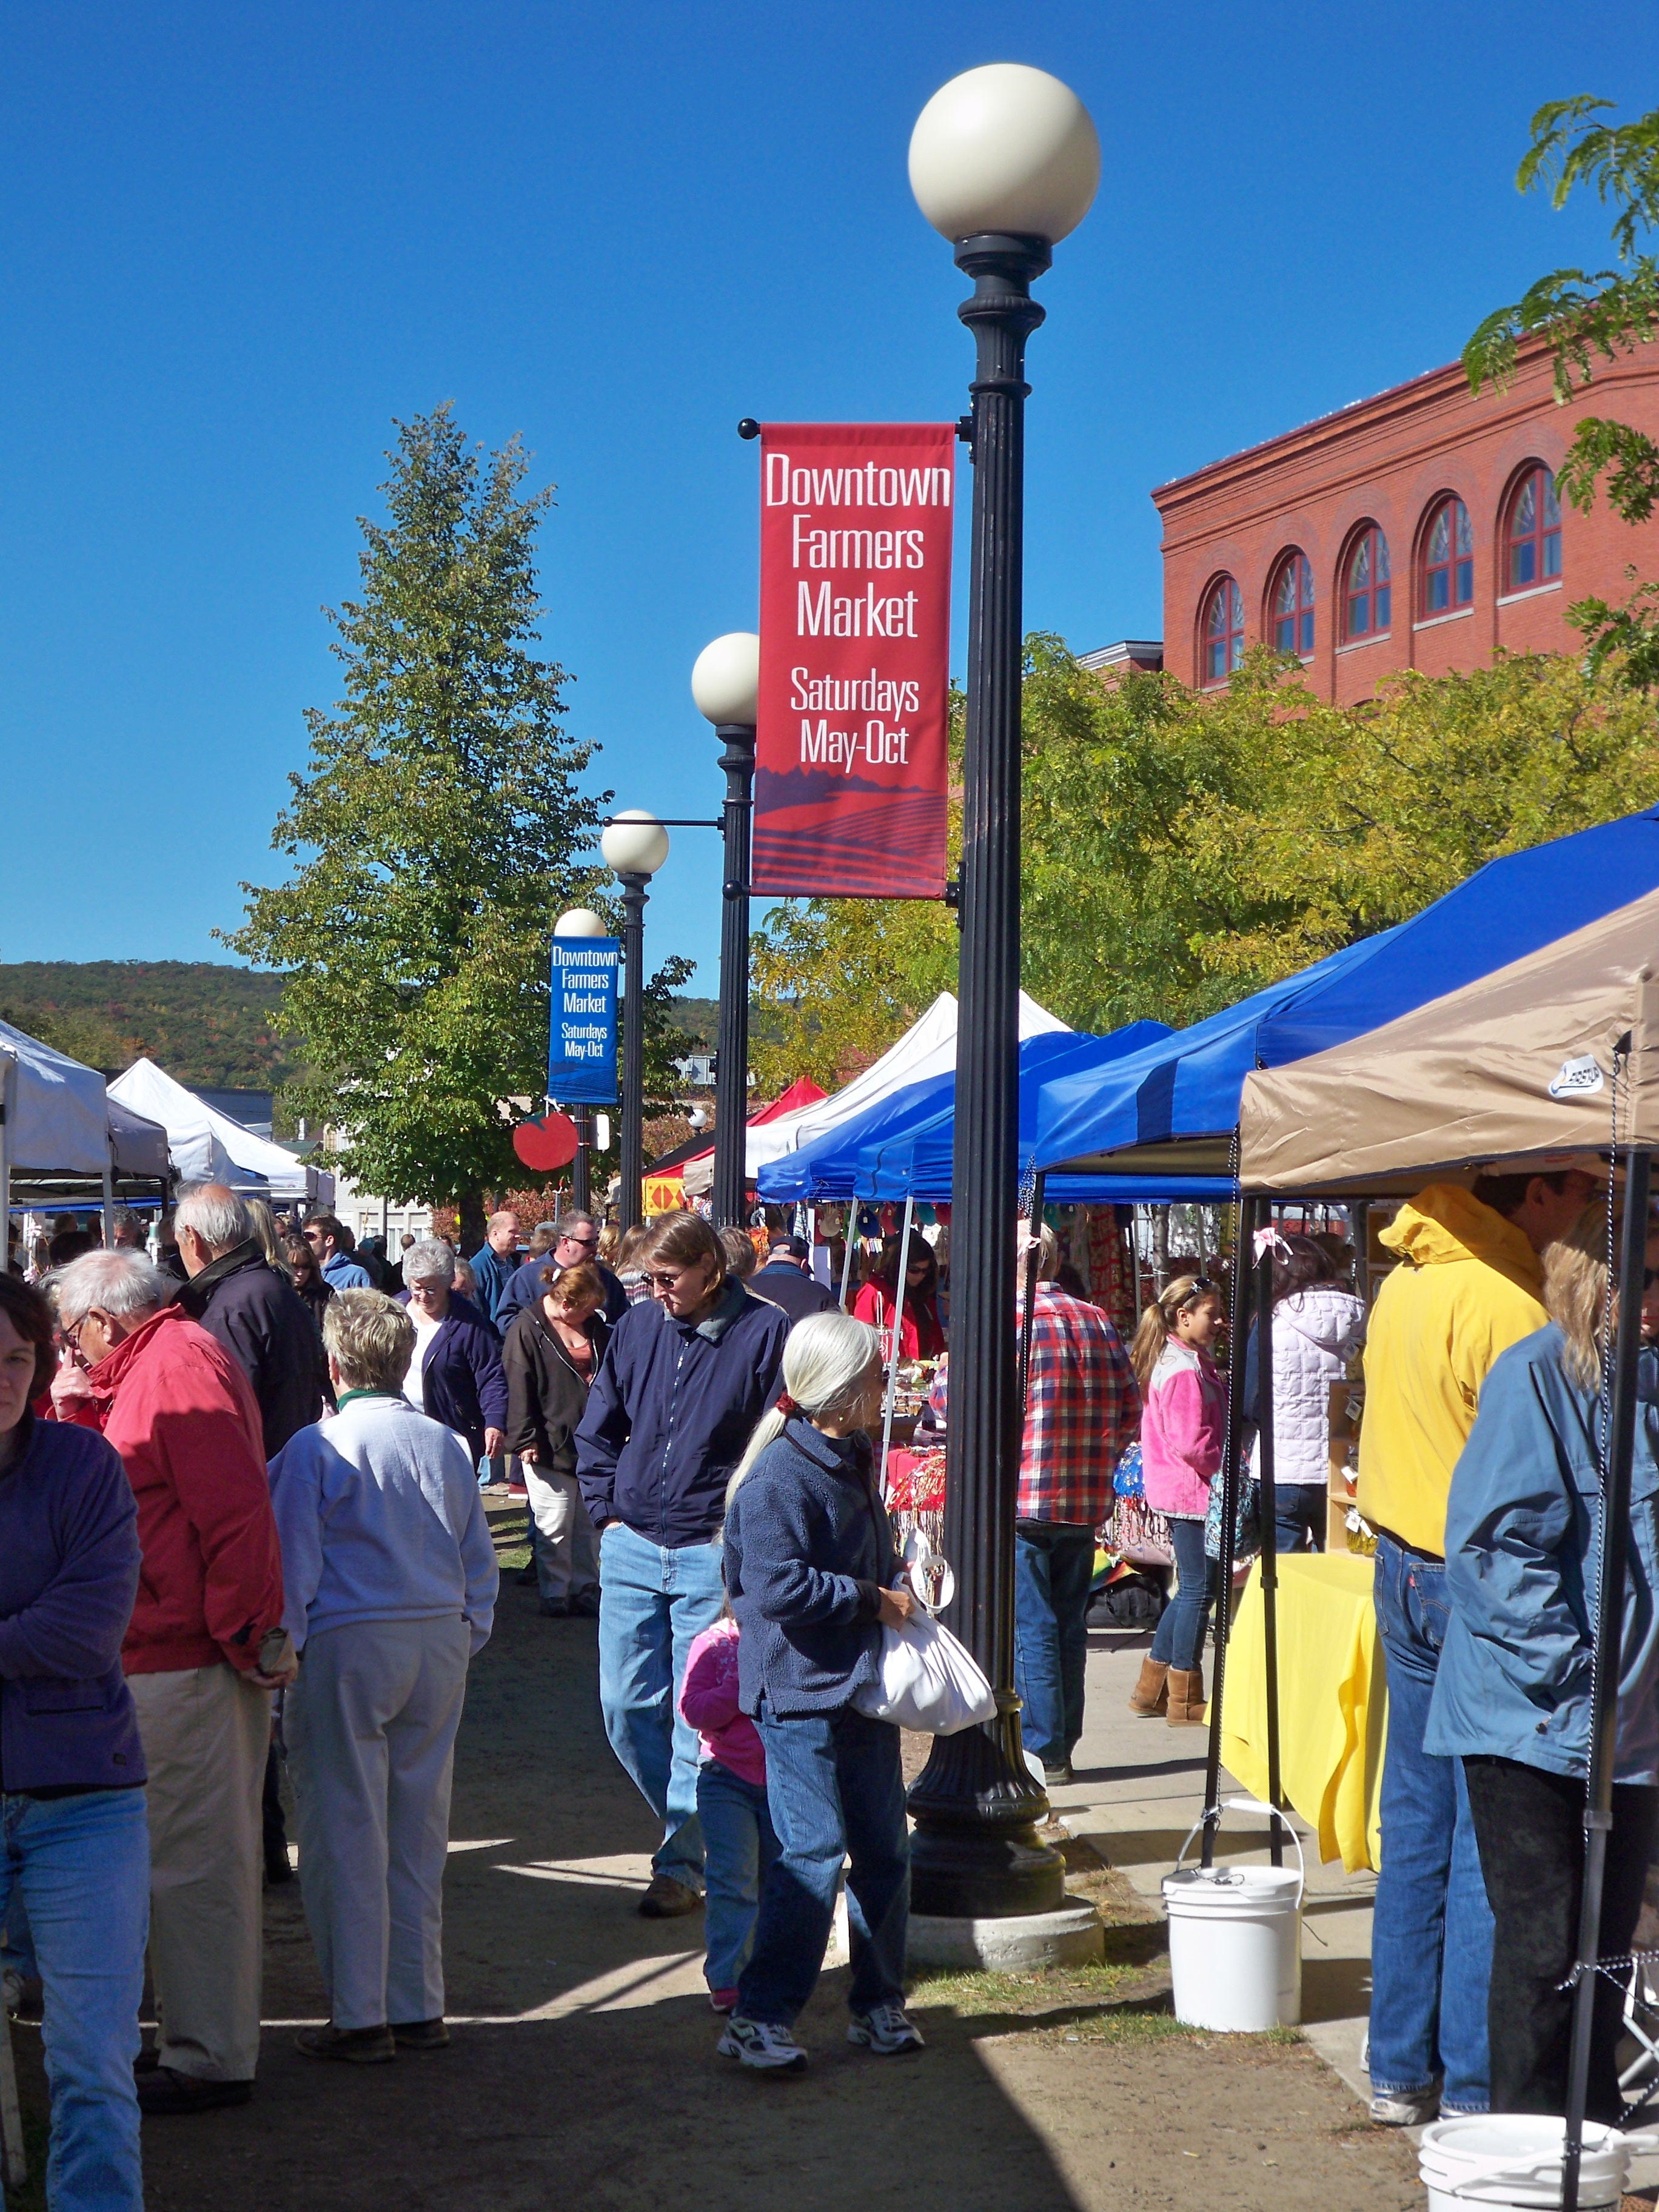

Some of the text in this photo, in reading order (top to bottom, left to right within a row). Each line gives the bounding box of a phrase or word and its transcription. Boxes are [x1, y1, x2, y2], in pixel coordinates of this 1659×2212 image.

[766, 453, 950, 506] Downtown
[793, 514, 923, 569] Farmers
[797, 581, 919, 637] Market
[791, 666, 919, 722] Saturdays
[800, 720, 909, 773] May-Oct
[552, 947, 617, 967] Downtown
[562, 968, 609, 988] Farmers
[563, 993, 606, 1013] Market
[561, 1023, 607, 1042] Saturdays
[565, 1041, 603, 1060] May-Oct
